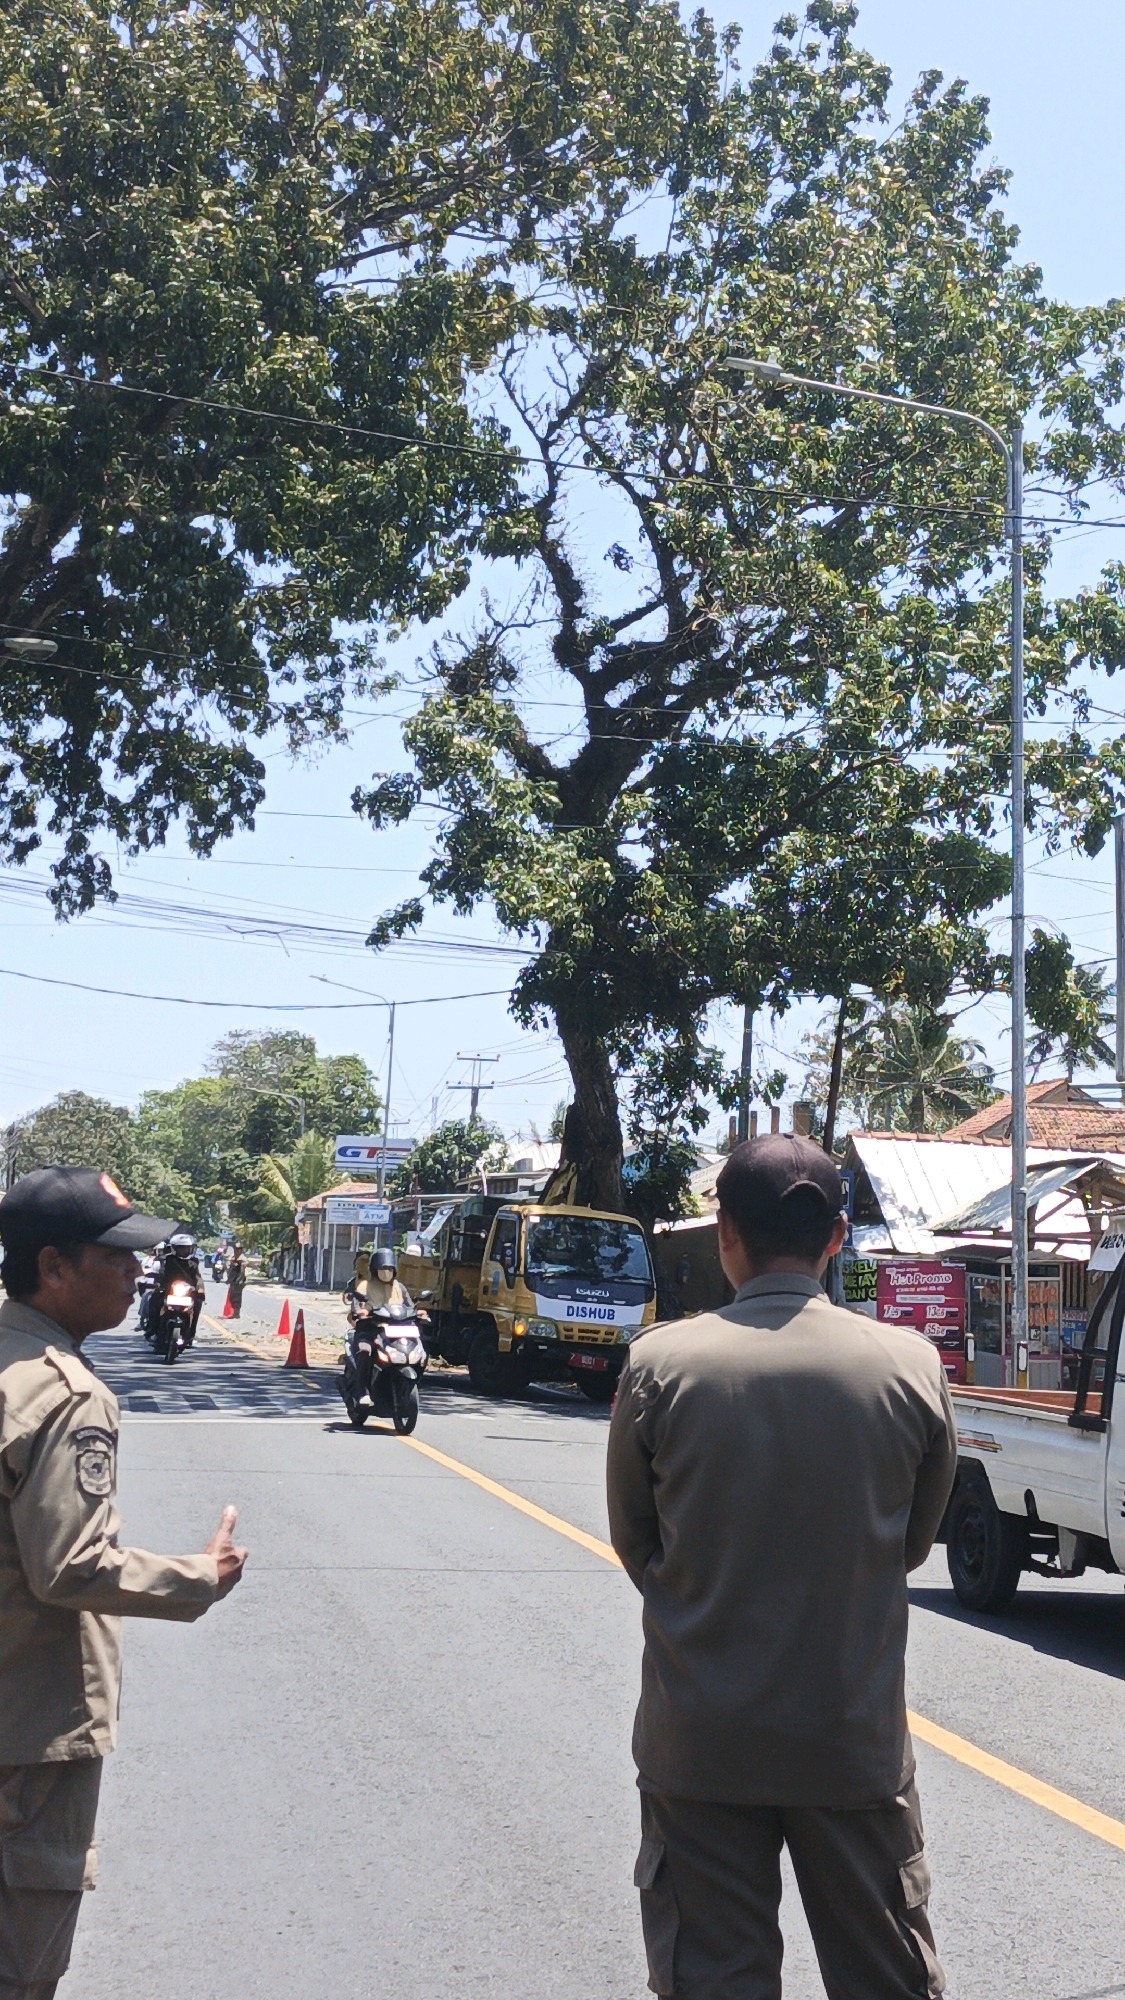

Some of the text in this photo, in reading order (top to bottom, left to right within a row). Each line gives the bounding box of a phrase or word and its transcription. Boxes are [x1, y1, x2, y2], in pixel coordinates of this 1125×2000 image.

[364, 1212, 385, 1220] ATM
[890, 1272, 953, 1286] Hot Promo
[576, 1287, 610, 1298] ISUZU
[566, 1305, 616, 1320] DISHUB
